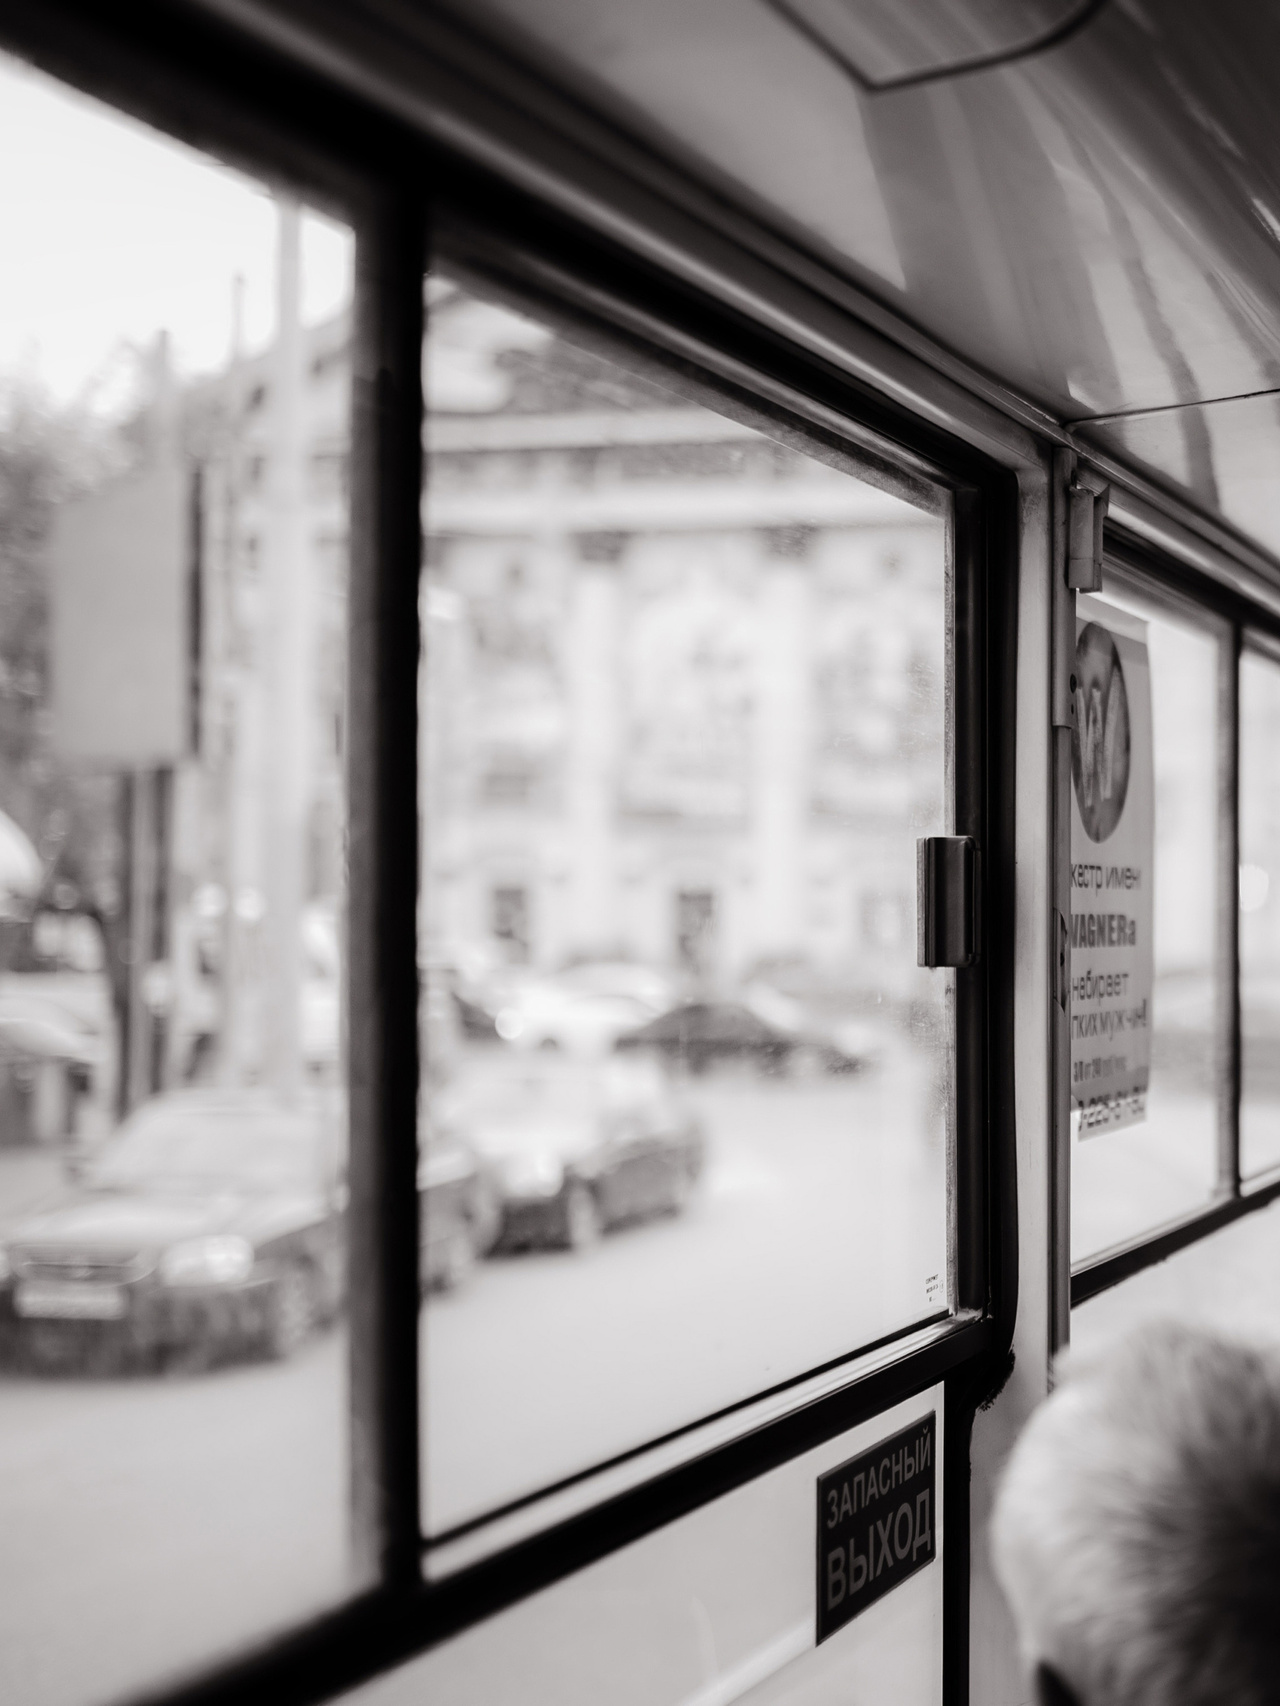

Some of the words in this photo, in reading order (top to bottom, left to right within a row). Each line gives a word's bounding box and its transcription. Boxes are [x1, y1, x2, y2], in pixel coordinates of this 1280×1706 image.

[1072, 969, 1129, 1007] набирает
[826, 1424, 931, 1529] ЗАПАСНЫЙ
[827, 1487, 932, 1612] ВЫХОД
